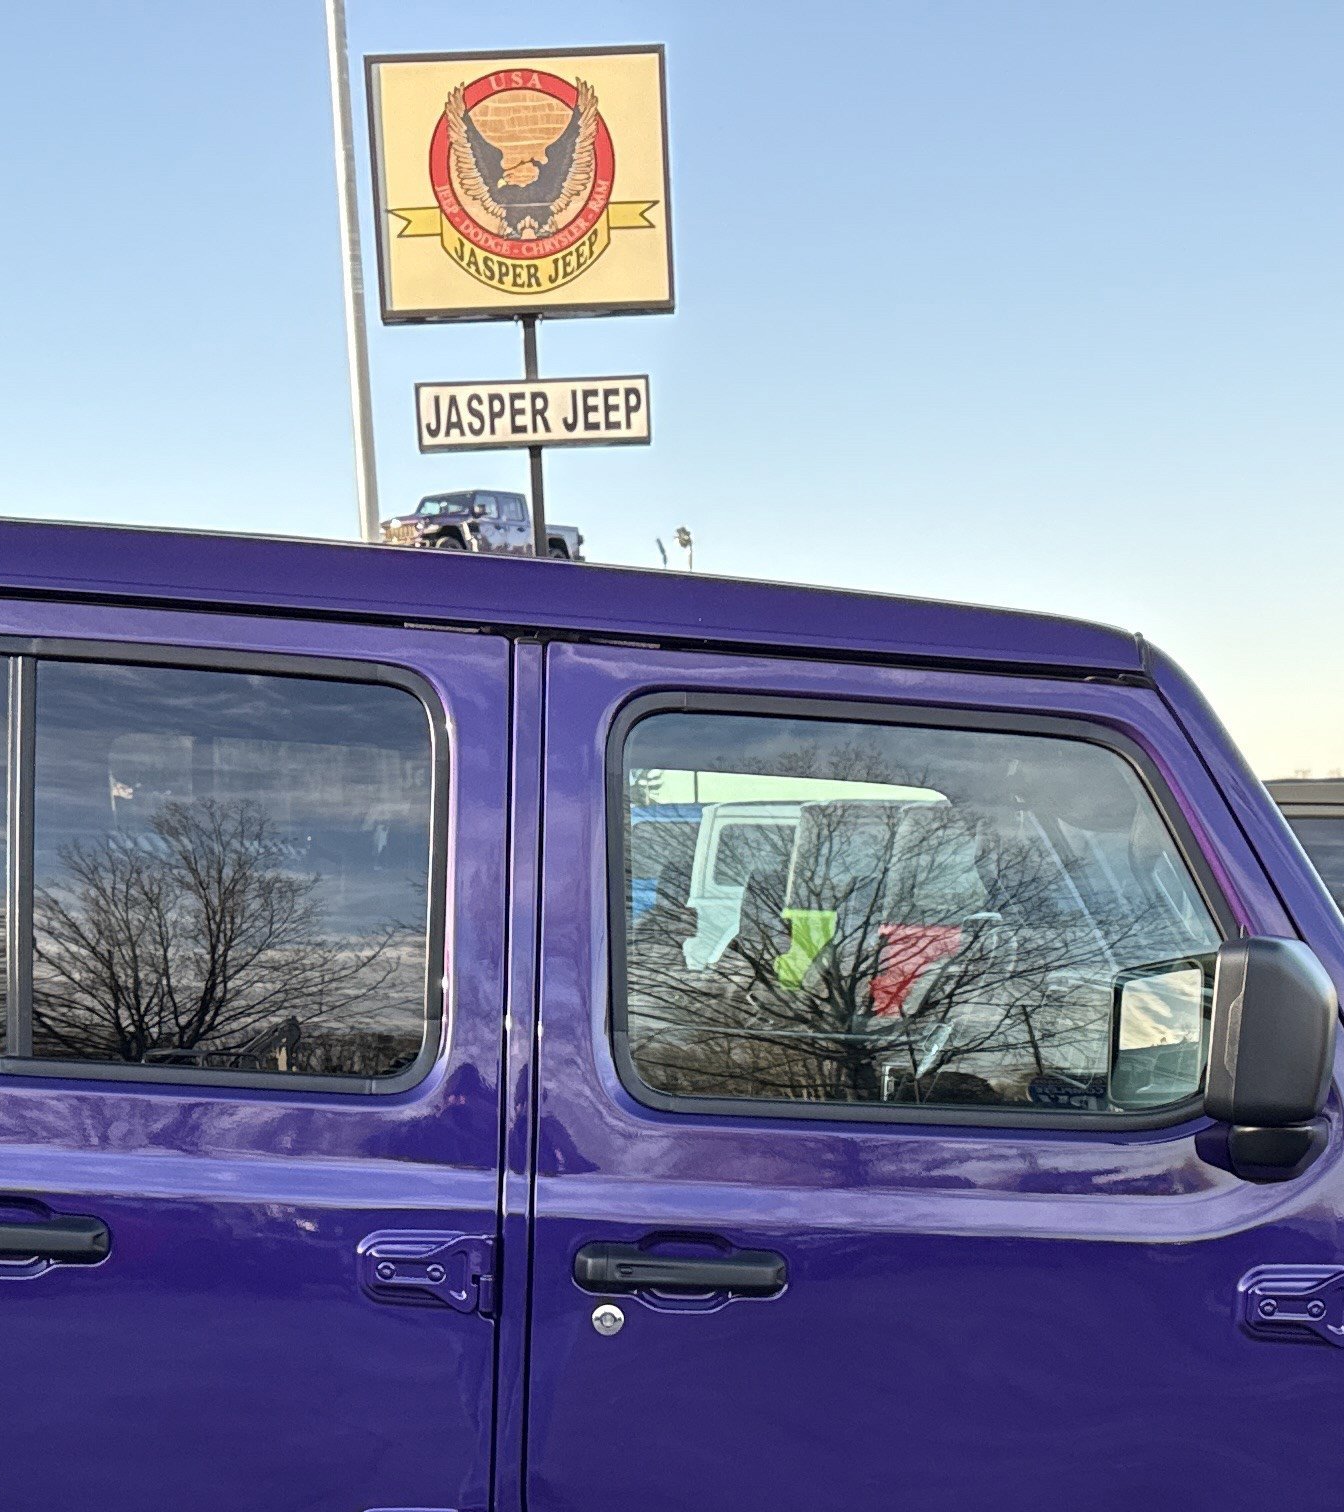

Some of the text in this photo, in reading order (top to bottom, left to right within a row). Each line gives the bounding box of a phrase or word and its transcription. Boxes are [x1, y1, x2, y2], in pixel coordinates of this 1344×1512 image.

[488, 71, 543, 91] USA
[436, 180, 611, 256] JEEP DODGE CHRYSLER RAM
[454, 228, 599, 289] JASPER JEEP
[425, 387, 642, 439] JASPER JEEP
